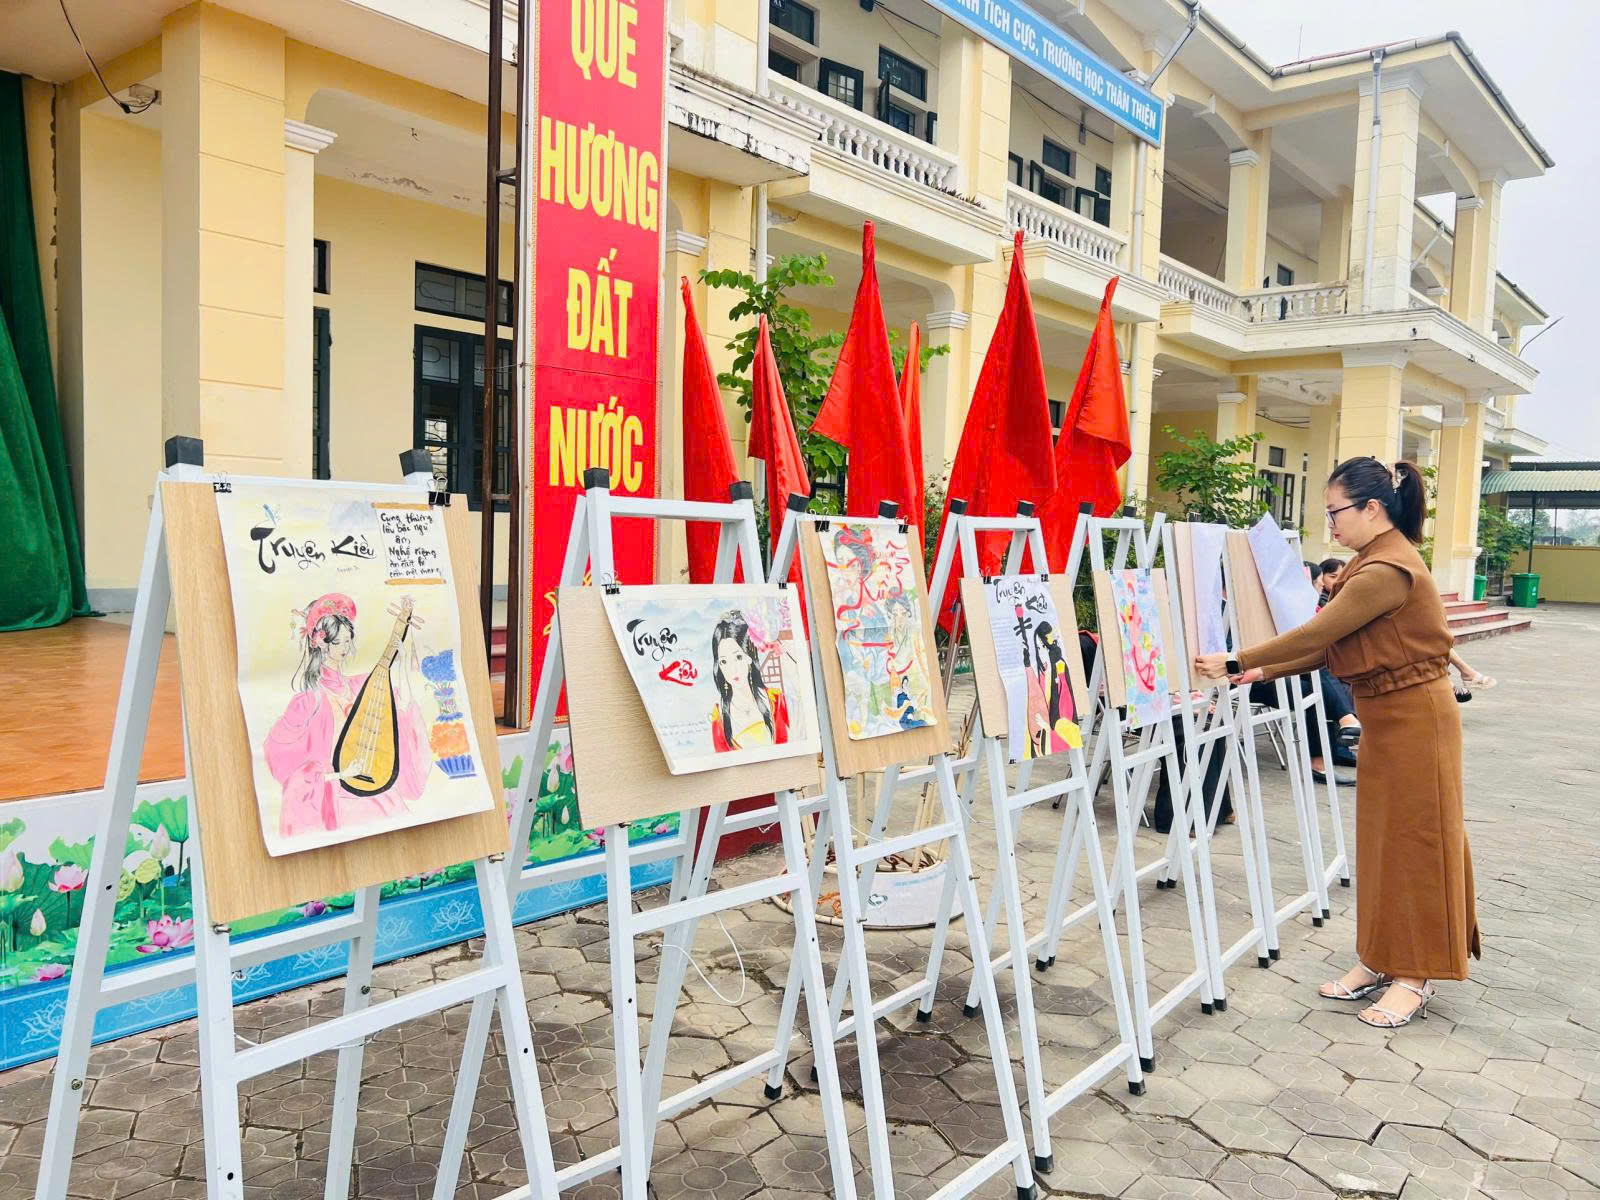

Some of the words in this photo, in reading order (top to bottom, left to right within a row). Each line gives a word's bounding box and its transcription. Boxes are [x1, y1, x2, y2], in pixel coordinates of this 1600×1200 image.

[1013, 18, 1039, 56] CỰC,
[1042, 36, 1083, 82] TRƯỜNG
[1084, 65, 1104, 96] HỌC
[1105, 81, 1130, 113] THÂN
[1131, 98, 1157, 131] THIỆN
[540, 115, 659, 233] HƯƠNG
[566, 248, 633, 358] ĐẤT
[548, 396, 644, 493] NƯỚC
[250, 526, 326, 574] Truyện
[331, 534, 377, 559] Kiều
[626, 619, 678, 661] Truyện
[659, 659, 698, 687] Kiều
